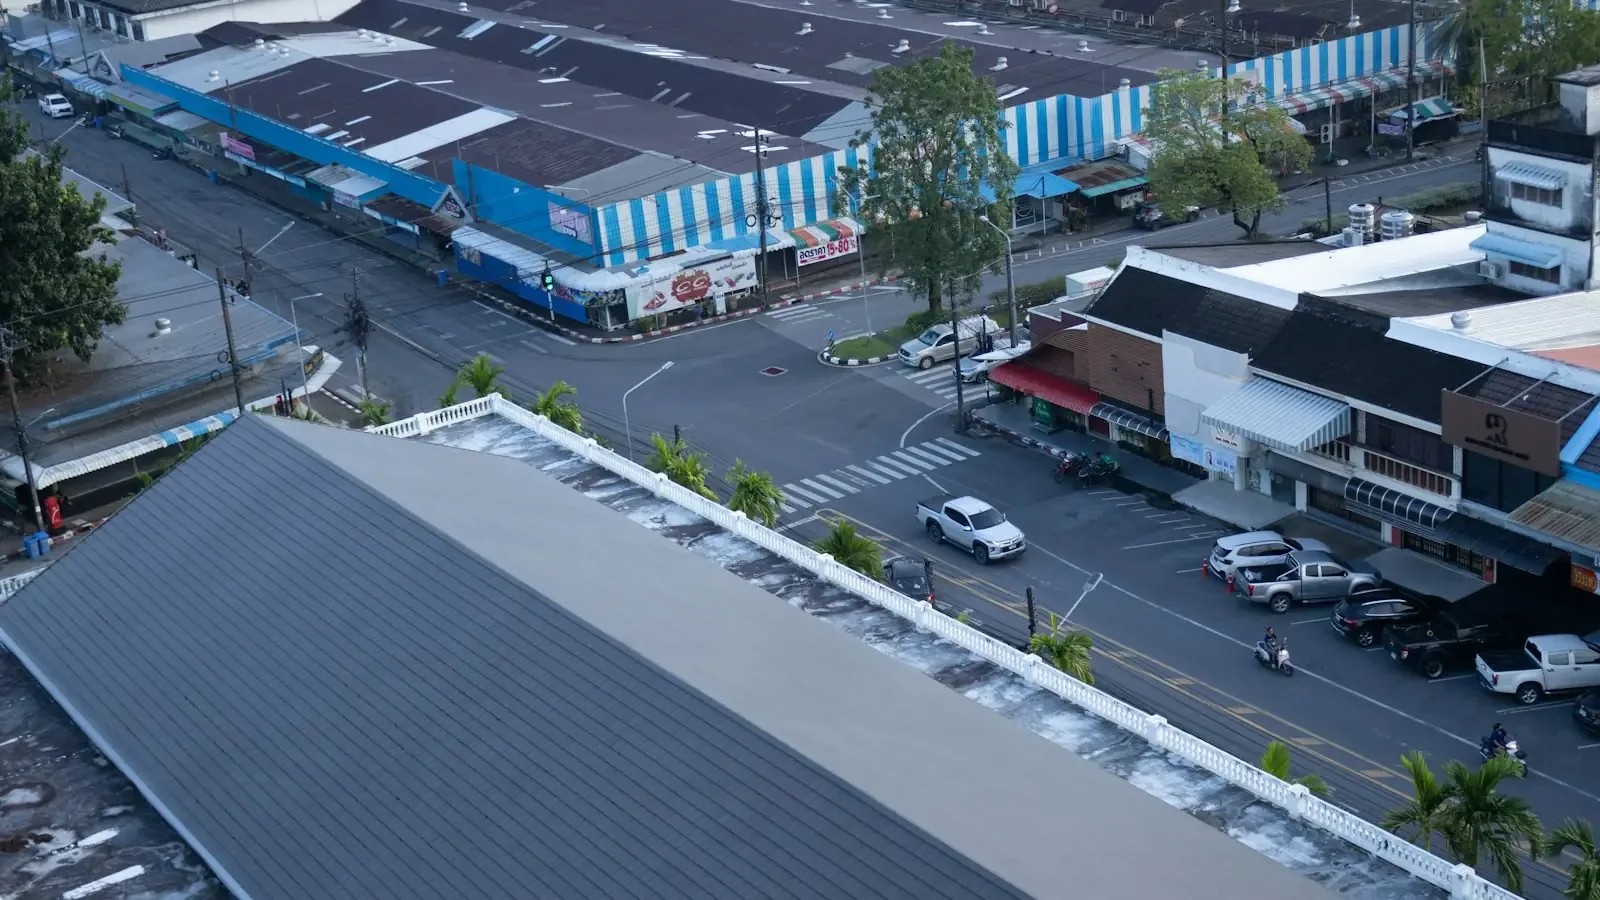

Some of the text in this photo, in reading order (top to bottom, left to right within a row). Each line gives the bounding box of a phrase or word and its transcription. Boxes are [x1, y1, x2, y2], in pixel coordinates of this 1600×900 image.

[800, 247, 826, 260] ลดราคา
[826, 240, 849, 256] 15-80
